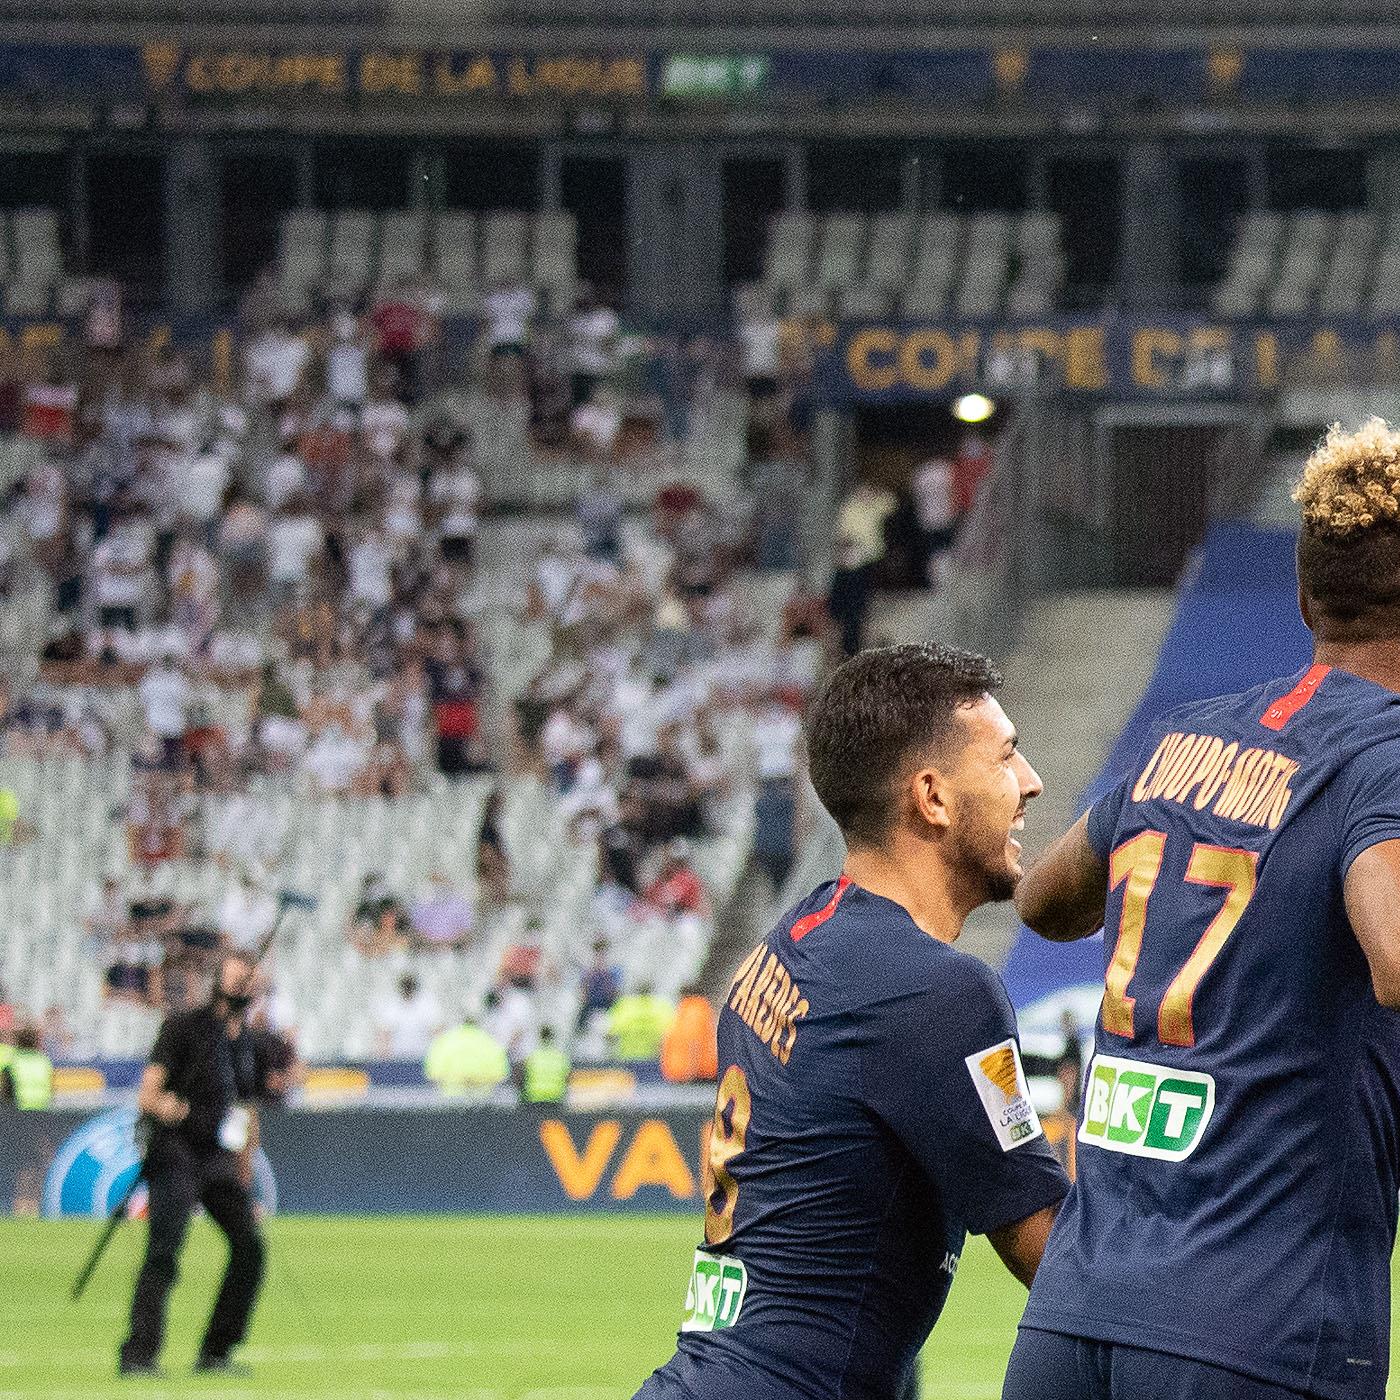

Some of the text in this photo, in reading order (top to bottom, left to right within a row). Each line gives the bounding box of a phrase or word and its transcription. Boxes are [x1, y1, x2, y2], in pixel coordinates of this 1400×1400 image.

[1102, 829, 1261, 1047] 17
[730, 941, 809, 1066] PAREDES
[539, 1119, 712, 1200] VA
[705, 1064, 752, 1246] 8
[1085, 1066, 1208, 1148] BKT
